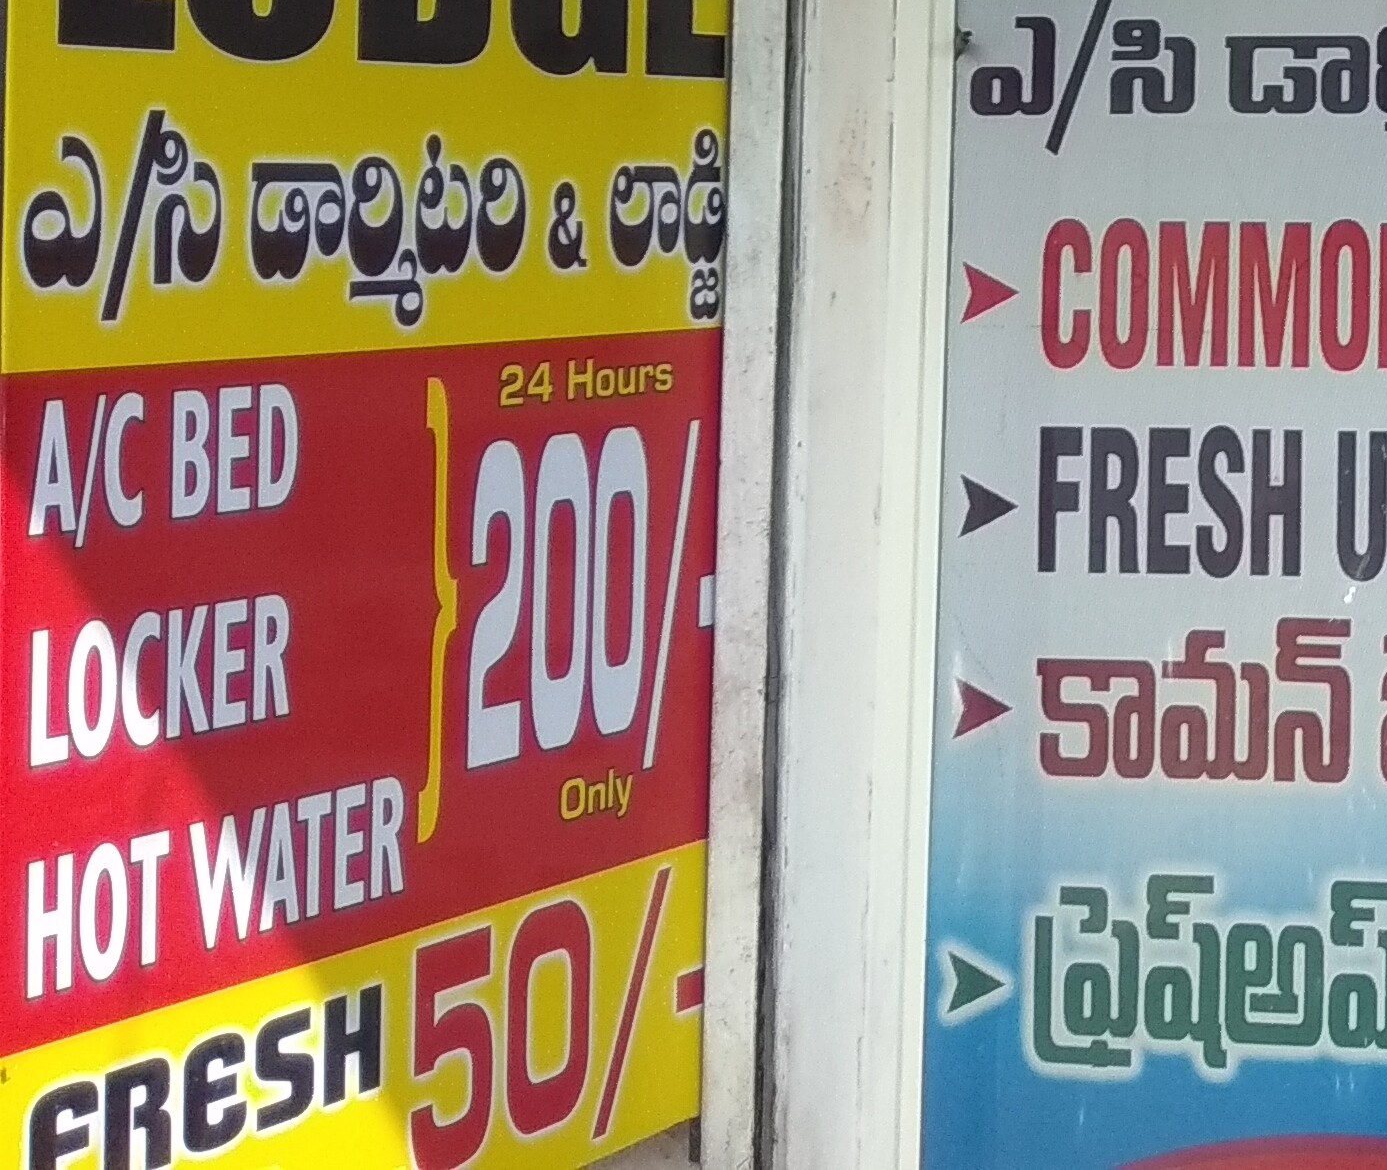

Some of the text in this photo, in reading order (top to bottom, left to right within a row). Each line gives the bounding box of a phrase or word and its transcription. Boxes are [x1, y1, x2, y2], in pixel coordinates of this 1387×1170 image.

[22, 109, 222, 322] ఎ/సి
[547, 180, 588, 269] &
[28, 382, 300, 549] A/C BED
[500, 358, 674, 407] 24 Hours
[1036, 424, 1304, 579] FRESH
[29, 593, 290, 769] LOCKER
[466, 419, 716, 771] 200/-
[1036, 617, 1353, 784] కామన్
[560, 769, 633, 821] Only
[25, 775, 405, 1000] HOT WATER
[28, 983, 384, 1170] FRESH
[409, 866, 704, 1170] 50/-
